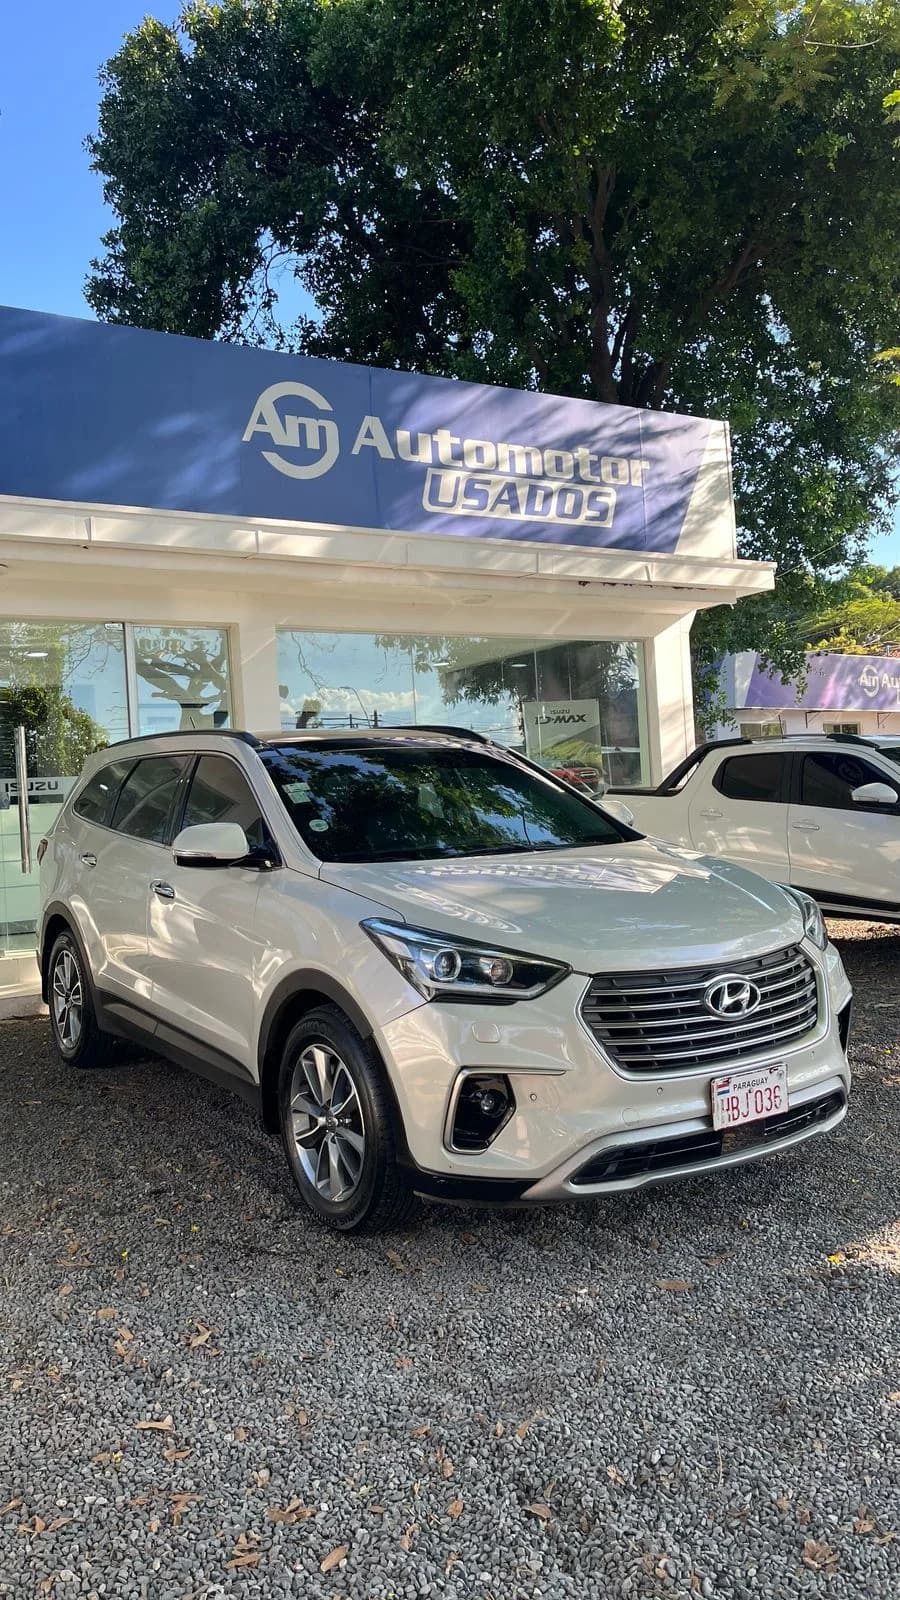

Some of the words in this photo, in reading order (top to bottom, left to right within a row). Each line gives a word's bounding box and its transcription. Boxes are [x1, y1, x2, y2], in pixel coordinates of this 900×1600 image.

[242, 381, 340, 480] Am
[352, 416, 650, 487] Automotor
[427, 472, 613, 524] USADOS
[733, 1077, 769, 1091] PARAGUAY
[754, 1084, 782, 1114] 036
